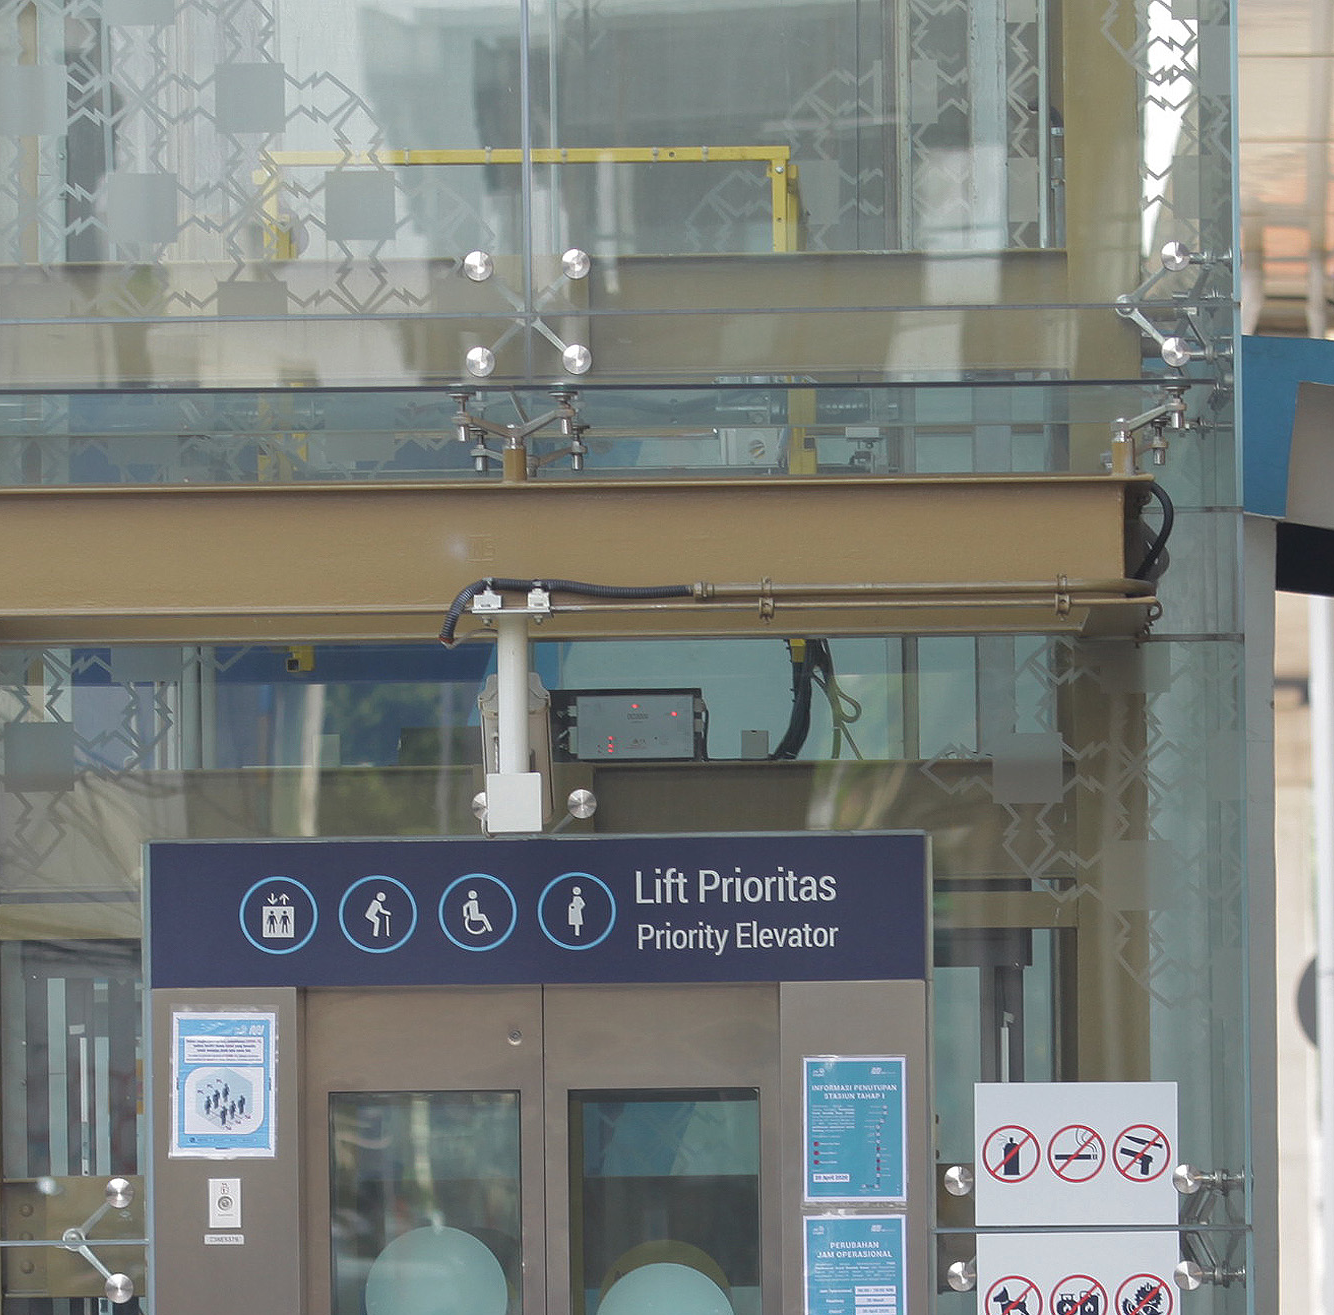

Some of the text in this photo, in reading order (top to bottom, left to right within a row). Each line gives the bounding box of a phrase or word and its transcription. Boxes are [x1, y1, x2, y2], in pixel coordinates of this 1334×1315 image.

[635, 866, 837, 904] Lift Prioritas
[637, 920, 839, 956] Priority Elevator
[823, 1092, 856, 1100] STASIUN
[829, 1241, 880, 1249] PERUBAHAN
[836, 1250, 893, 1258] OPERASIONAL
